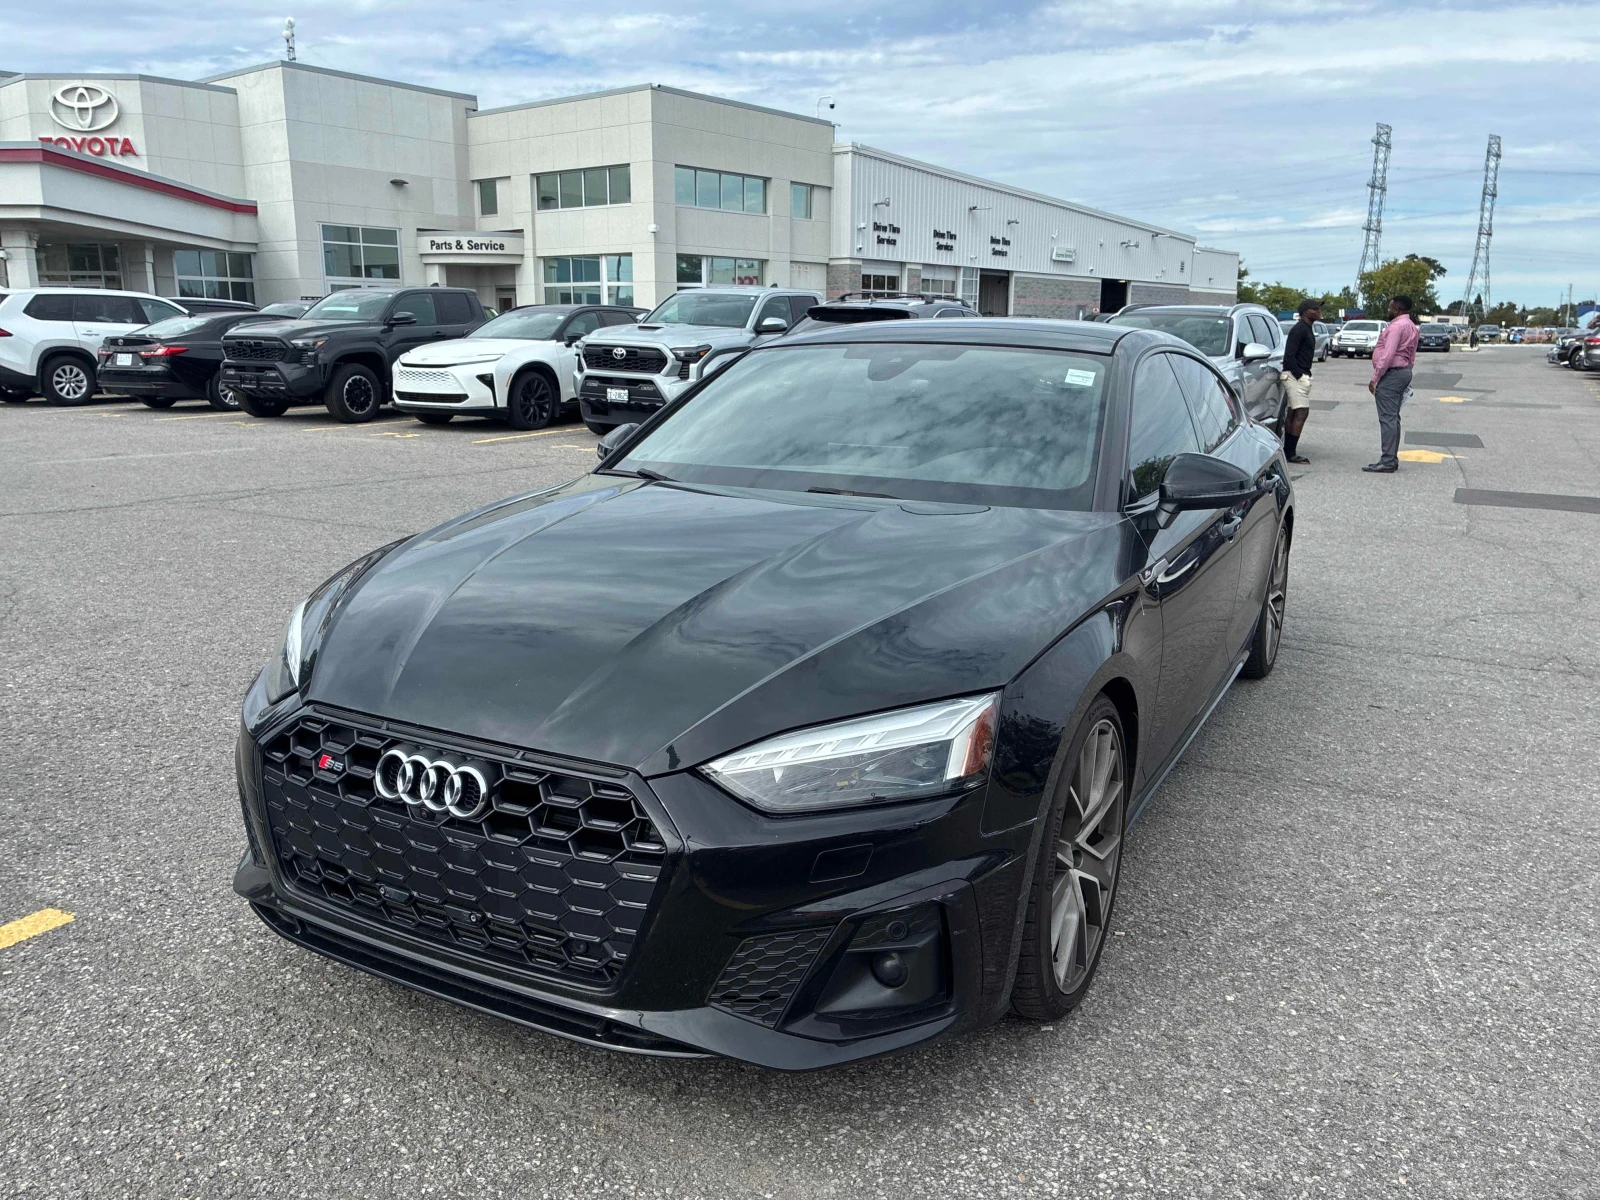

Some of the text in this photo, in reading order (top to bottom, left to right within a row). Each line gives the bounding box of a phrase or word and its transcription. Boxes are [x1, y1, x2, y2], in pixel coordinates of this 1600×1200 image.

[873, 222, 900, 234] Drive Thru
[933, 229, 957, 240] Drive Thru
[430, 239, 505, 251] Parts & Service
[876, 235, 897, 246] Service
[936, 242, 953, 251] Service
[992, 247, 1008, 257] Service
[1044, 816, 1061, 892] Continental
